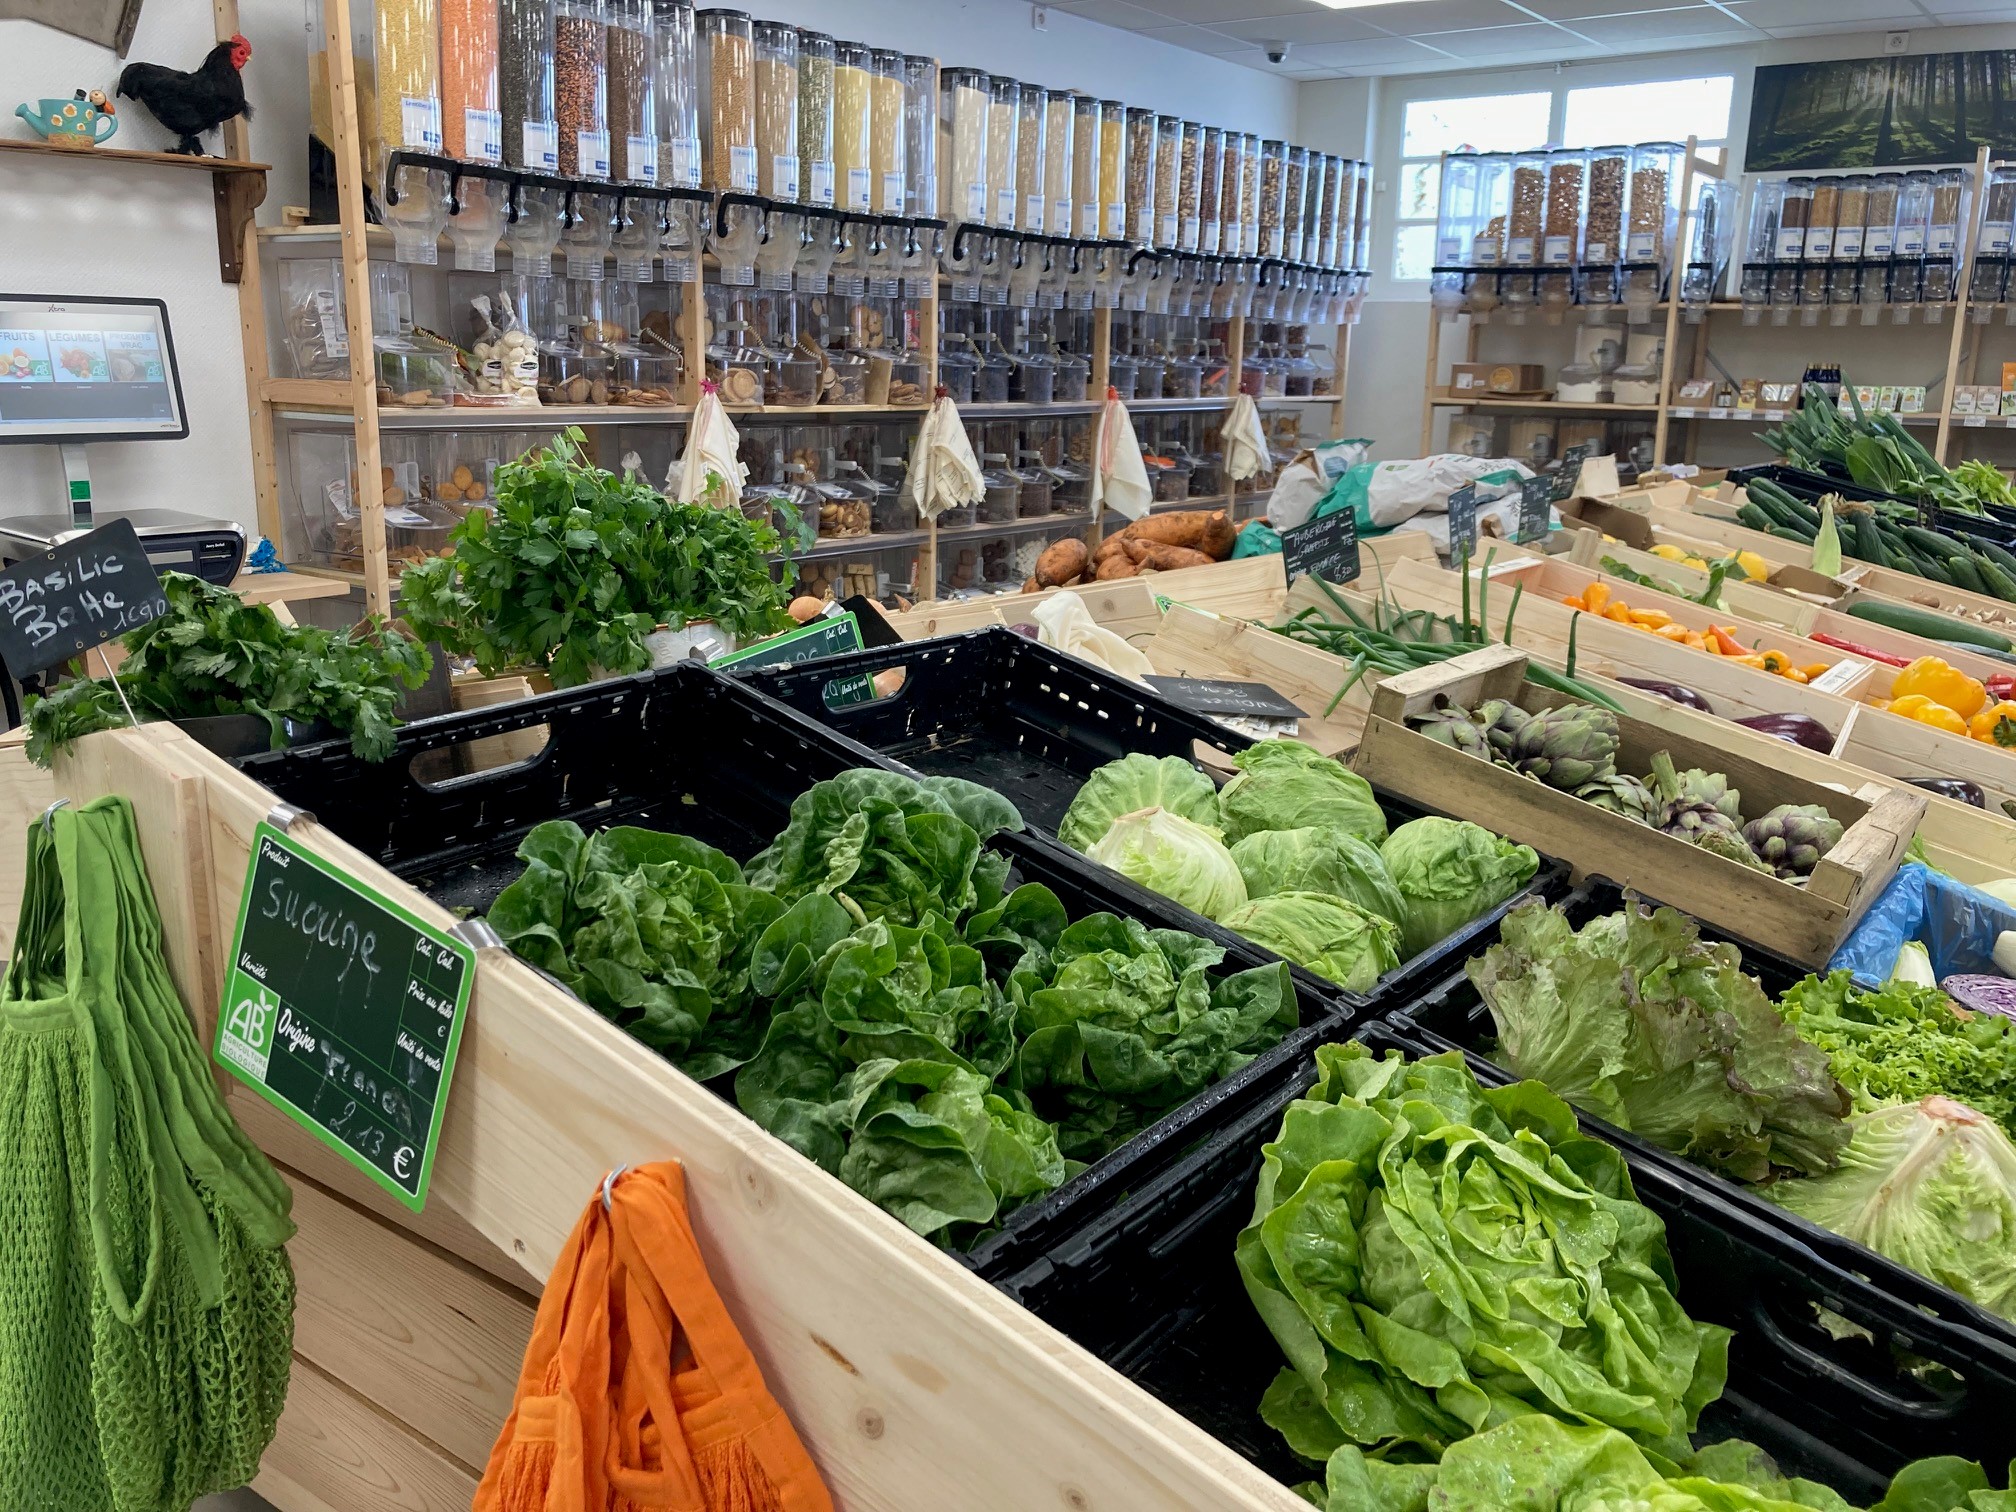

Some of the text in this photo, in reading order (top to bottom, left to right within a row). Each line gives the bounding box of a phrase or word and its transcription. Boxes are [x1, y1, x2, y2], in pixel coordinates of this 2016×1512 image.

[261, 841, 291, 868] Produit
[415, 937, 432, 958] Cat.
[240, 952, 268, 979] Variété
[407, 980, 453, 1020] Prix au kilo
[228, 998, 266, 1048] AB
[277, 1008, 316, 1054] Origine
[221, 1043, 266, 1080] BIOLOGIQUE
[223, 1032, 268, 1069] AGRICULTURE
[397, 1031, 417, 1054] Unité
[414, 1046, 425, 1061] de
[393, 1146, 416, 1180] €
